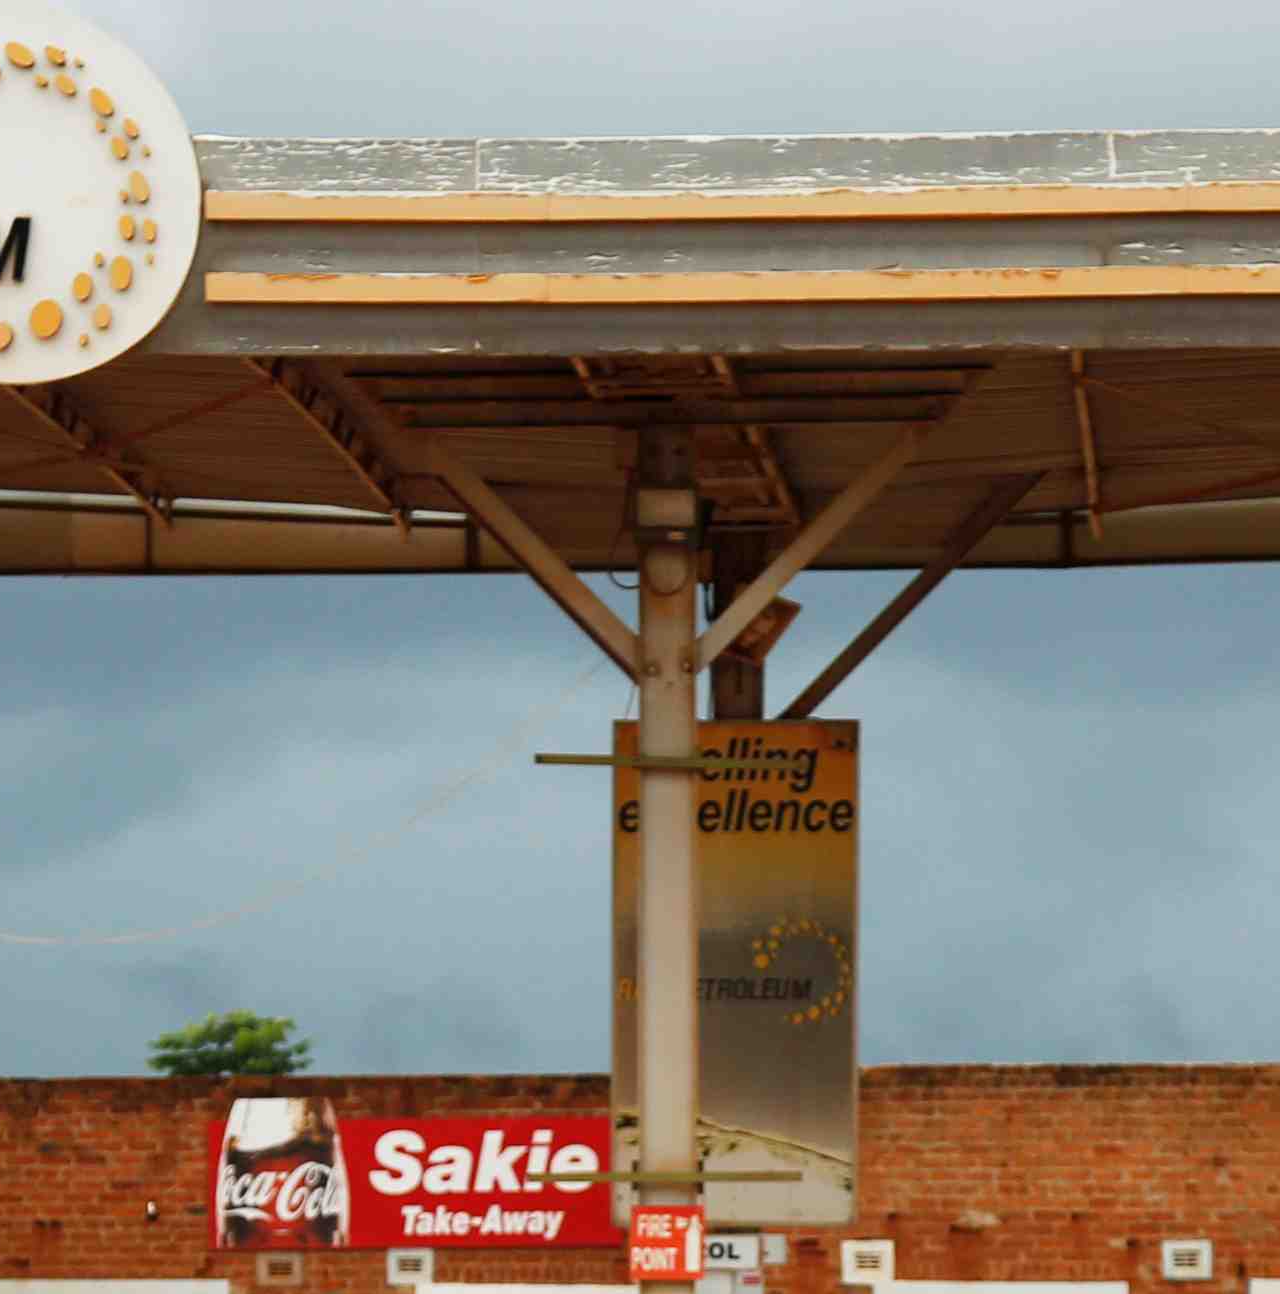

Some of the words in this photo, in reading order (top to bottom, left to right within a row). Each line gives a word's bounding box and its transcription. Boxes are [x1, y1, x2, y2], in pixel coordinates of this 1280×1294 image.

[619, 788, 855, 832] eellence
[368, 1128, 600, 1197] Sakie
[399, 1203, 565, 1240] Take-Away
[636, 1213, 672, 1238] FIRE
[630, 1246, 678, 1272] POINT
